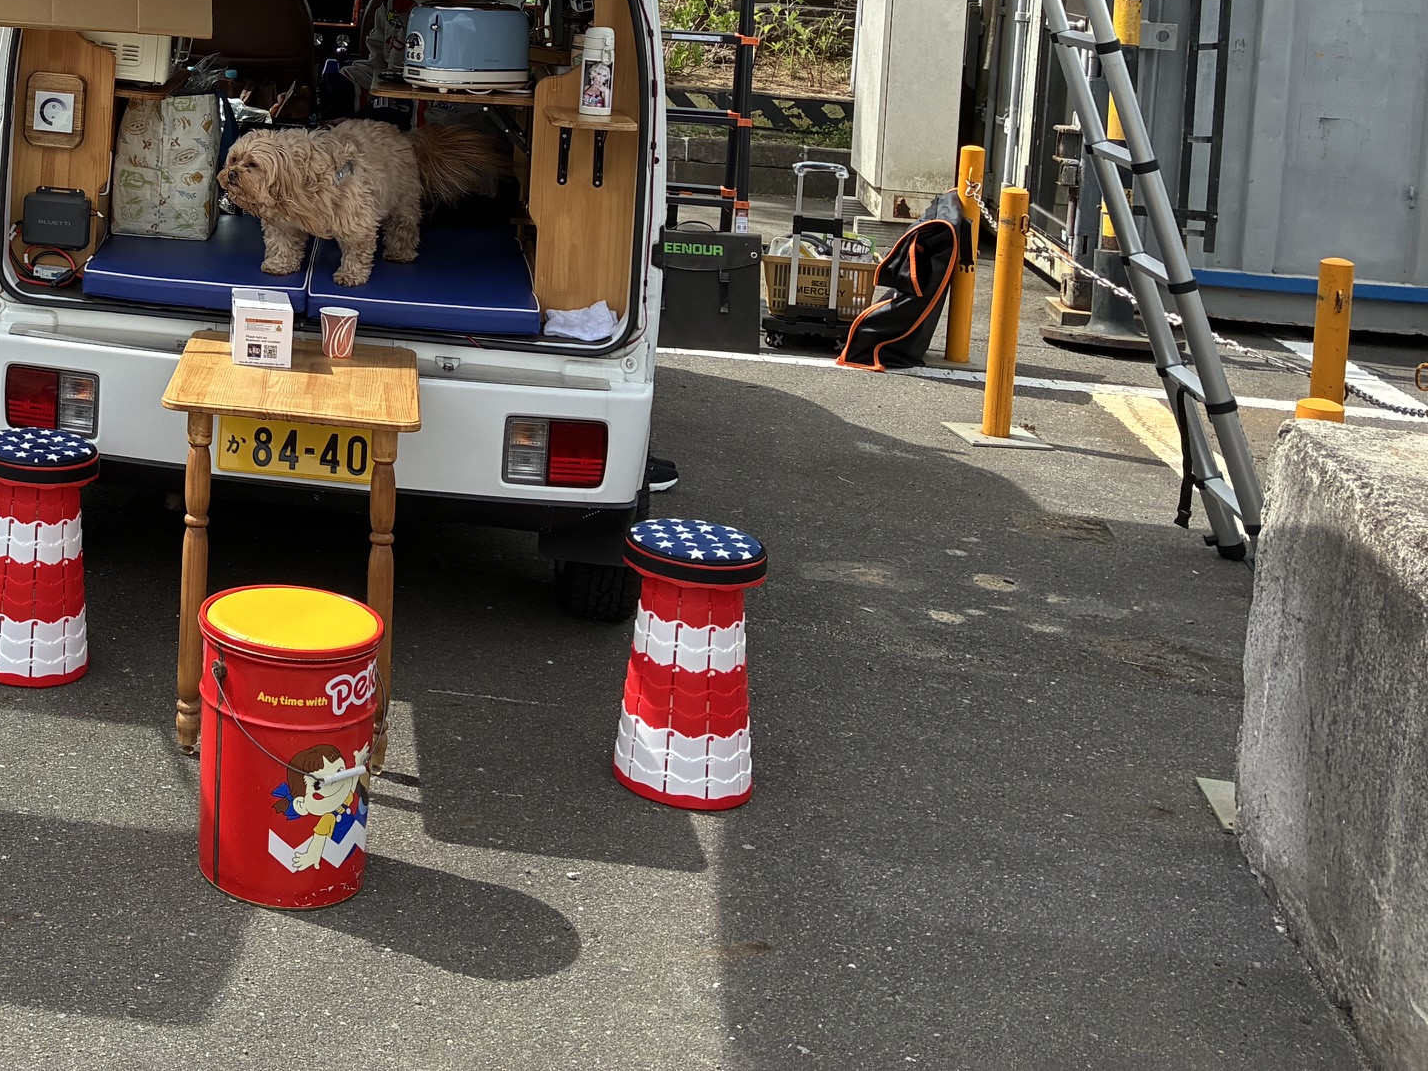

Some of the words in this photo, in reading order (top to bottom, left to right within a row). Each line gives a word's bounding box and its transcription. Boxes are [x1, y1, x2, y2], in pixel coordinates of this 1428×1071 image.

[663, 242, 724, 257] EENOUR
[797, 285, 846, 298] MERCUY
[226, 434, 246, 454] か
[252, 427, 368, 476] 84-40
[257, 691, 278, 707] Any
[279, 695, 304, 707] time
[305, 696, 328, 707] with
